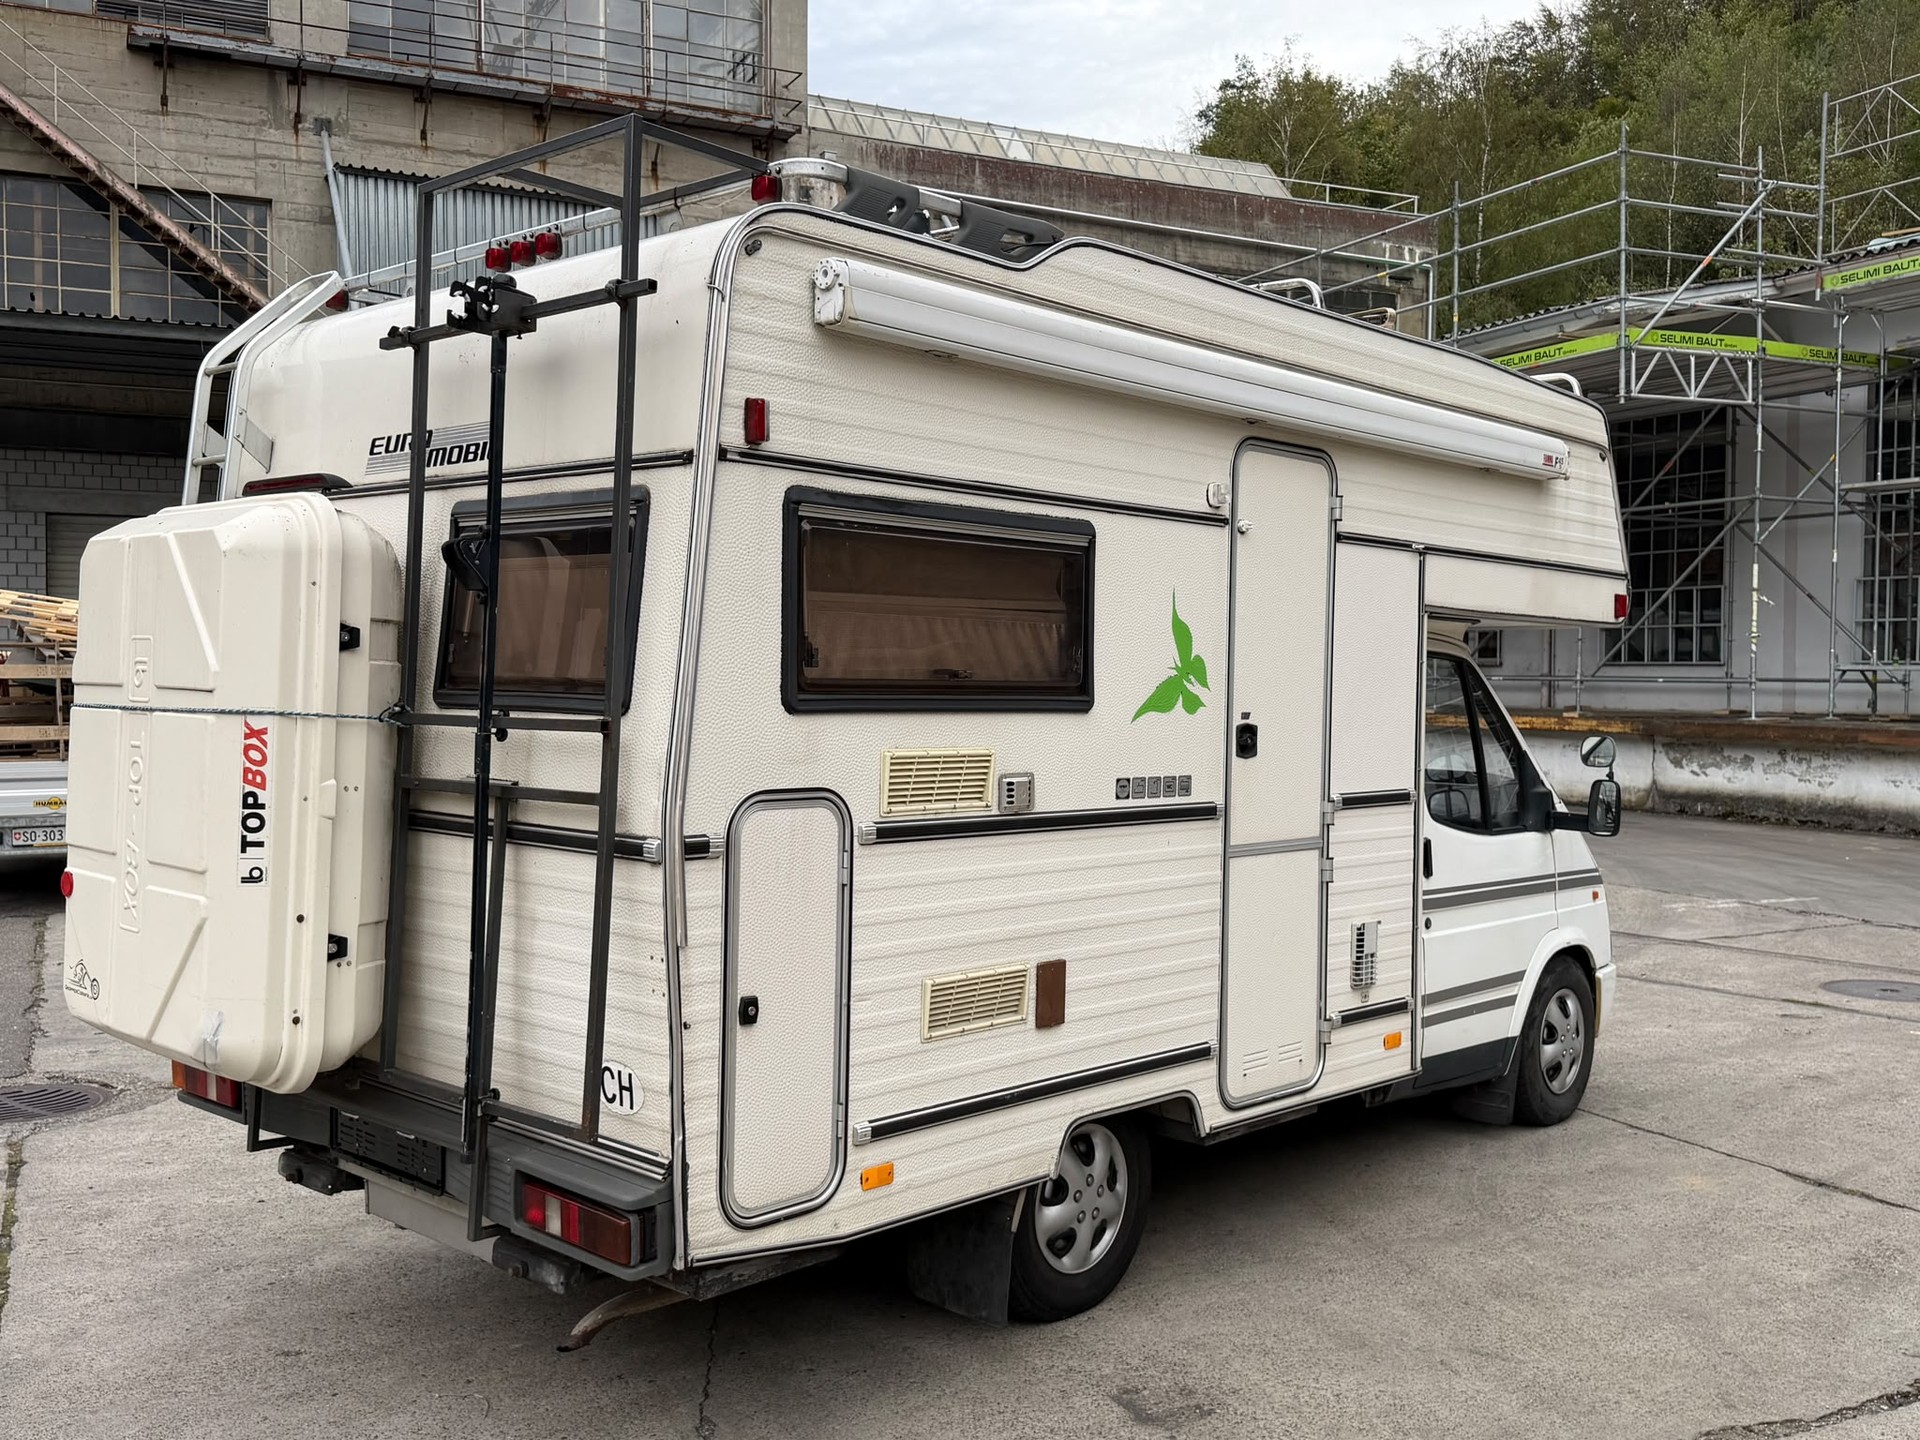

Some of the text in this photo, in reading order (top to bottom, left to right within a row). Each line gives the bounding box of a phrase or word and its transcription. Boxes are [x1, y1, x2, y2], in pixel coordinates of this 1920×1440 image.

[1840, 258, 1919, 284] SELIMI BAUT
[1660, 333, 1694, 345] SELIMI
[1696, 336, 1725, 348] BAUT
[1499, 354, 1533, 368] SELIMI
[1534, 347, 1564, 362] BAUT
[1809, 348, 1839, 361] SELIM
[1841, 353, 1868, 364] BAUT
[425, 441, 490, 468] MOBI
[601, 1066, 634, 1110] CH
